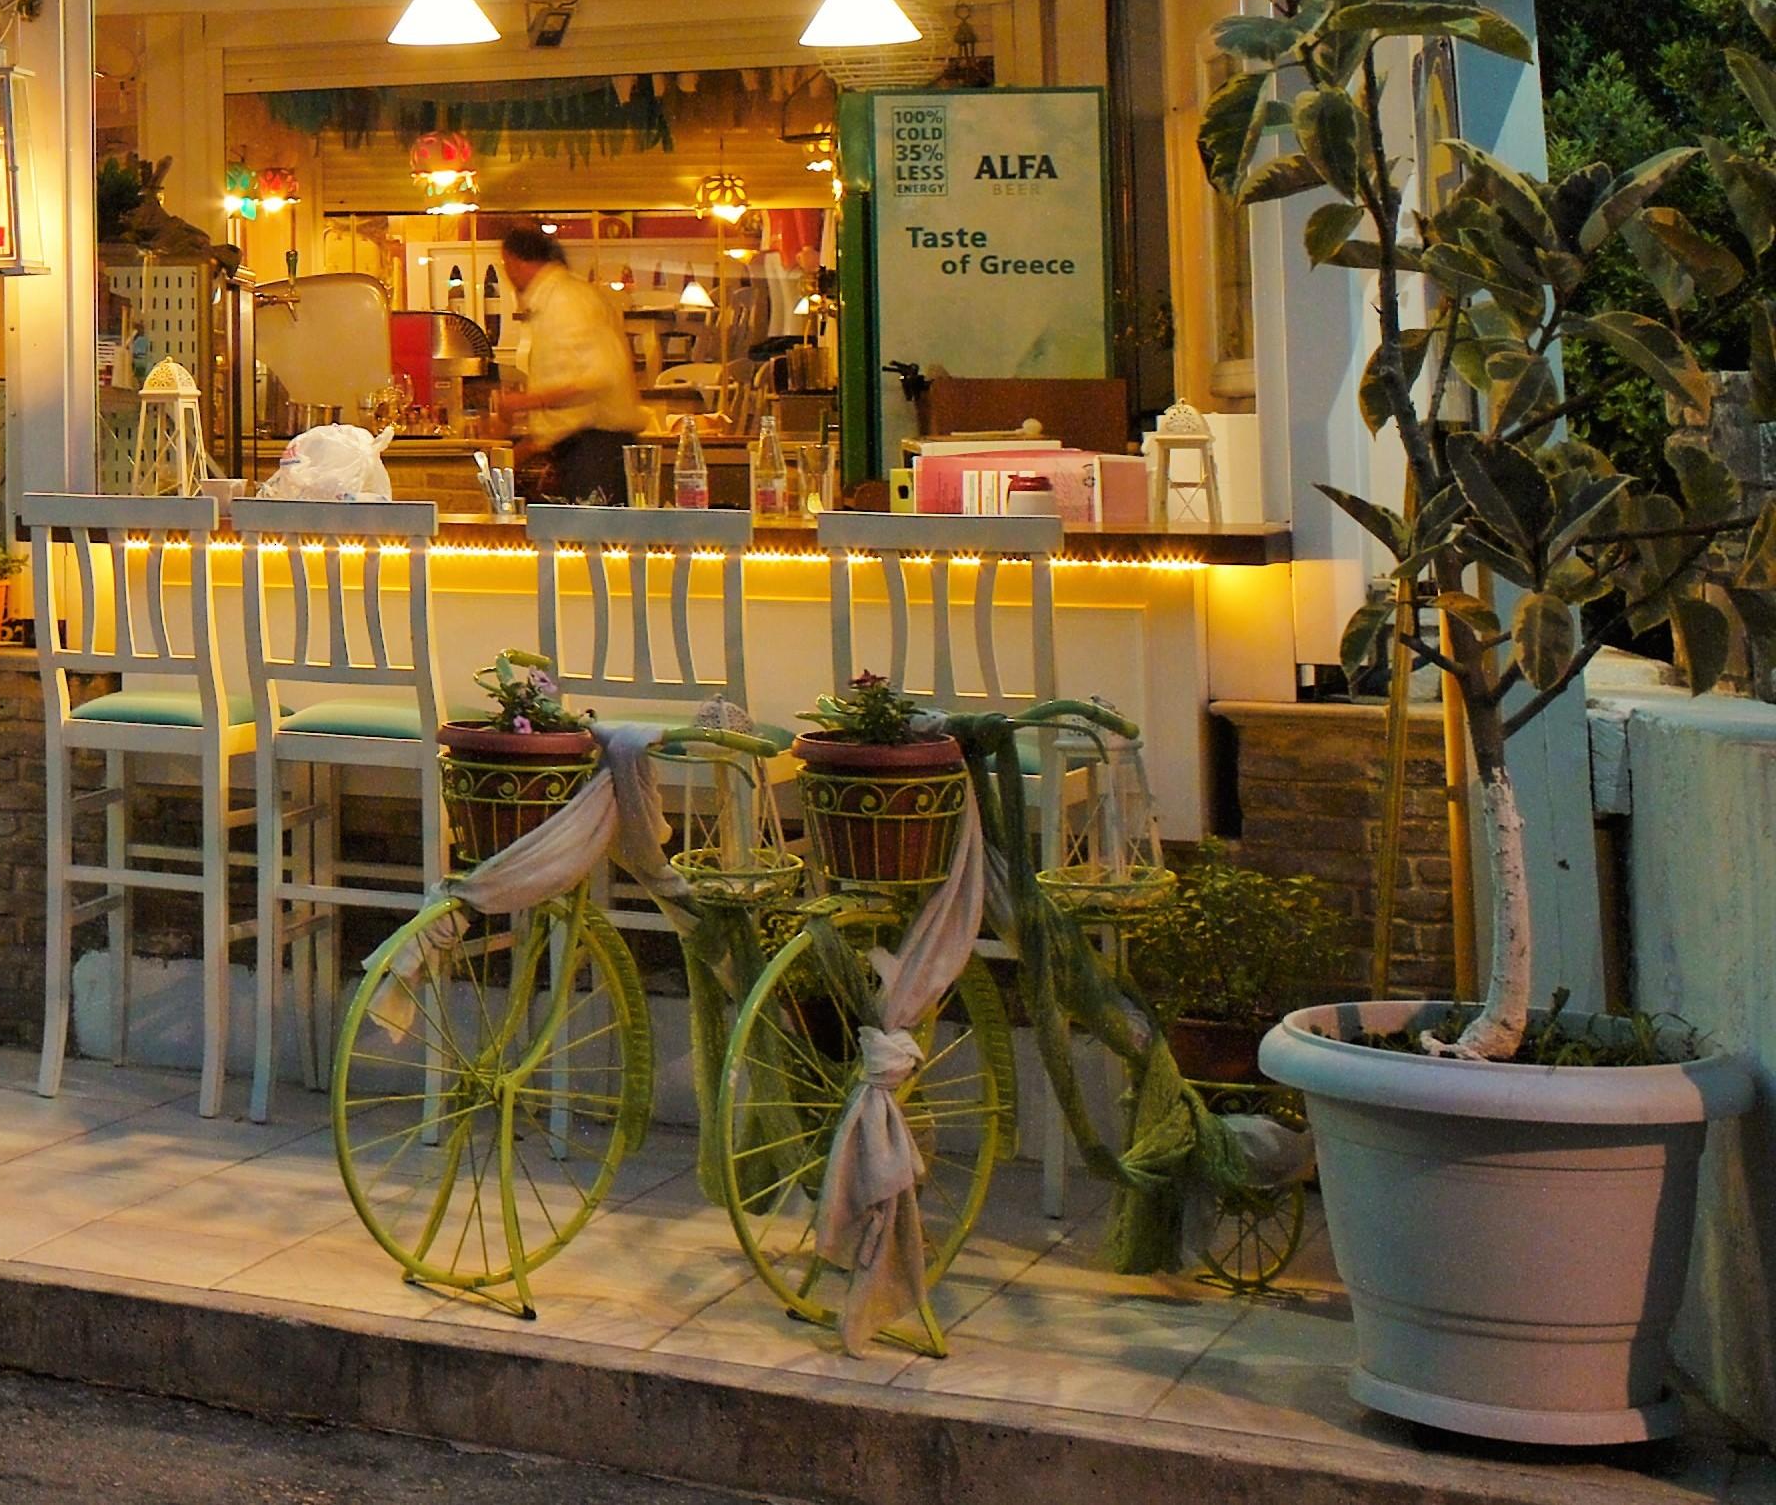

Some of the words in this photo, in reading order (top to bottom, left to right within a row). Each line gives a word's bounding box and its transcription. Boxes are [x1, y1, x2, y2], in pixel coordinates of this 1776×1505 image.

[895, 110, 943, 124] 100%
[895, 127, 942, 141] COLD
[895, 144, 944, 161] 35%
[896, 165, 945, 181] LESS
[974, 155, 1058, 179] ALFA
[897, 183, 945, 194] ENERGY
[993, 183, 1041, 195] BEER
[905, 226, 987, 248] Taste
[941, 254, 971, 275] of
[980, 255, 1075, 275] Greece
